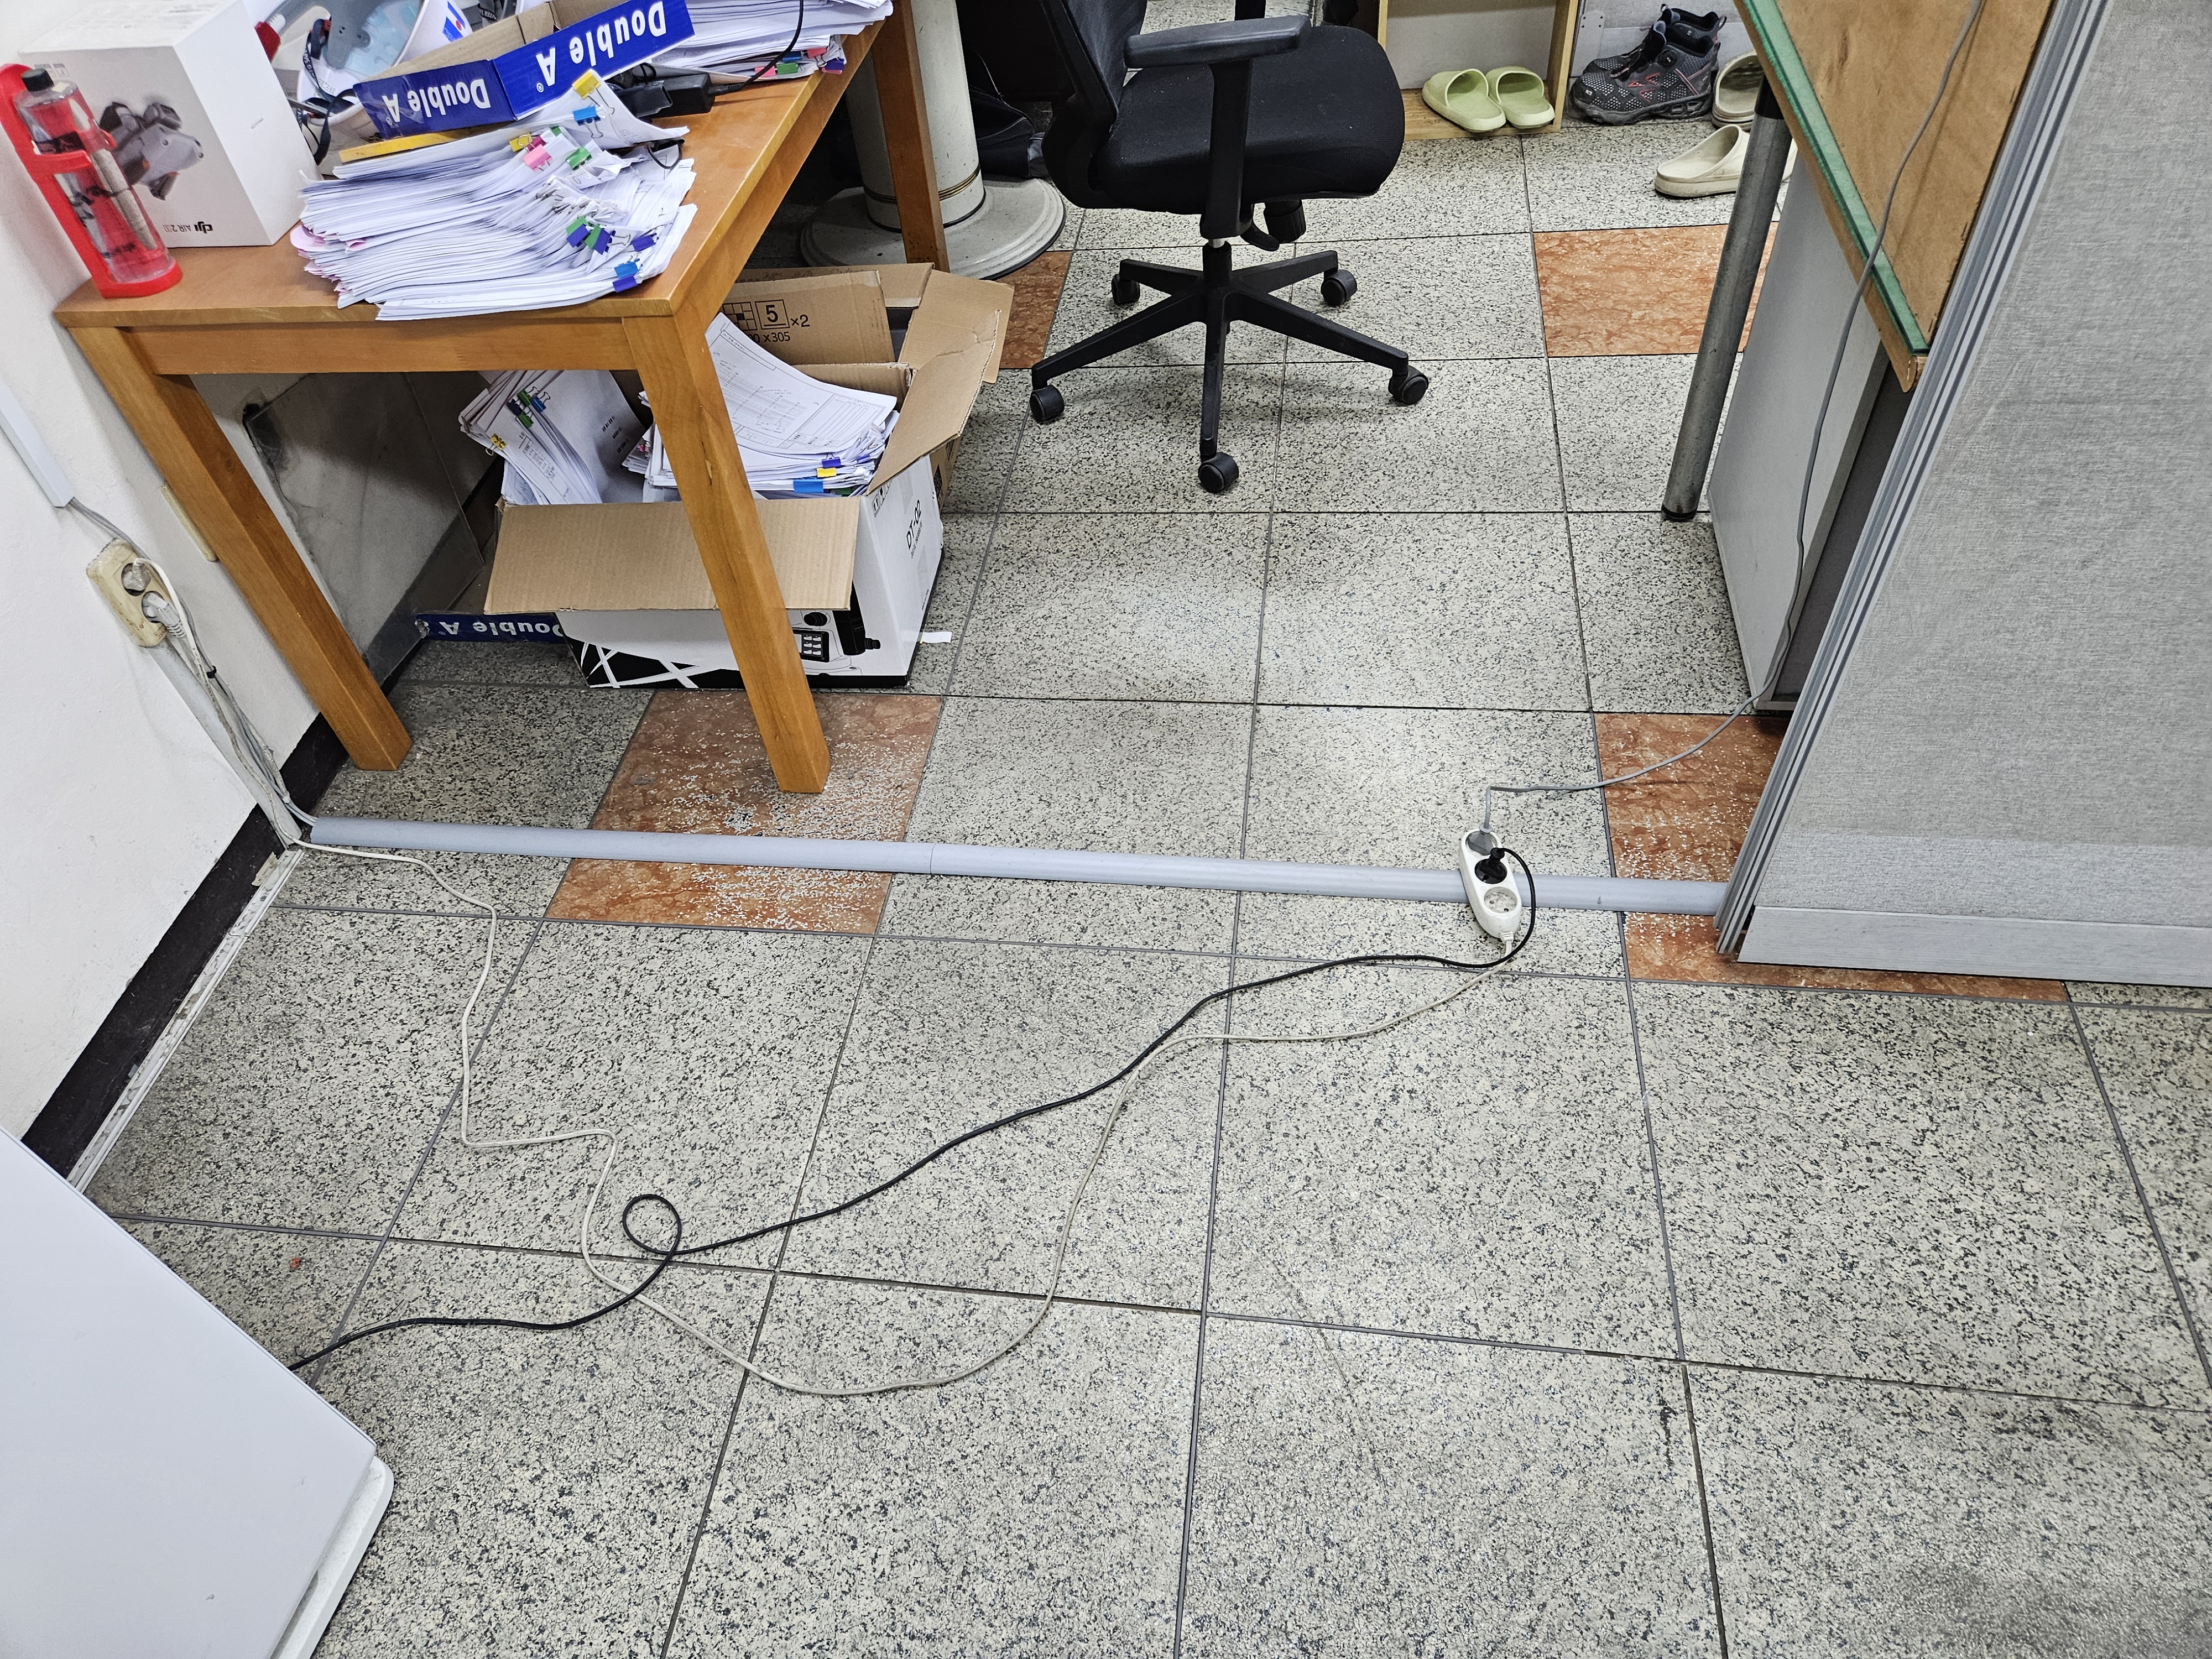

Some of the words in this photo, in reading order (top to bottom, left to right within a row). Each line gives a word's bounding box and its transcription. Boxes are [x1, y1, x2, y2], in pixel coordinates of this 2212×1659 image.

[570, 1, 666, 67] Double
[536, 47, 556, 87] A
[382, 93, 401, 123] A
[407, 79, 491, 118] Double
[765, 304, 779, 323] 5
[906, 499, 922, 550] DT-02
[439, 622, 460, 635] A
